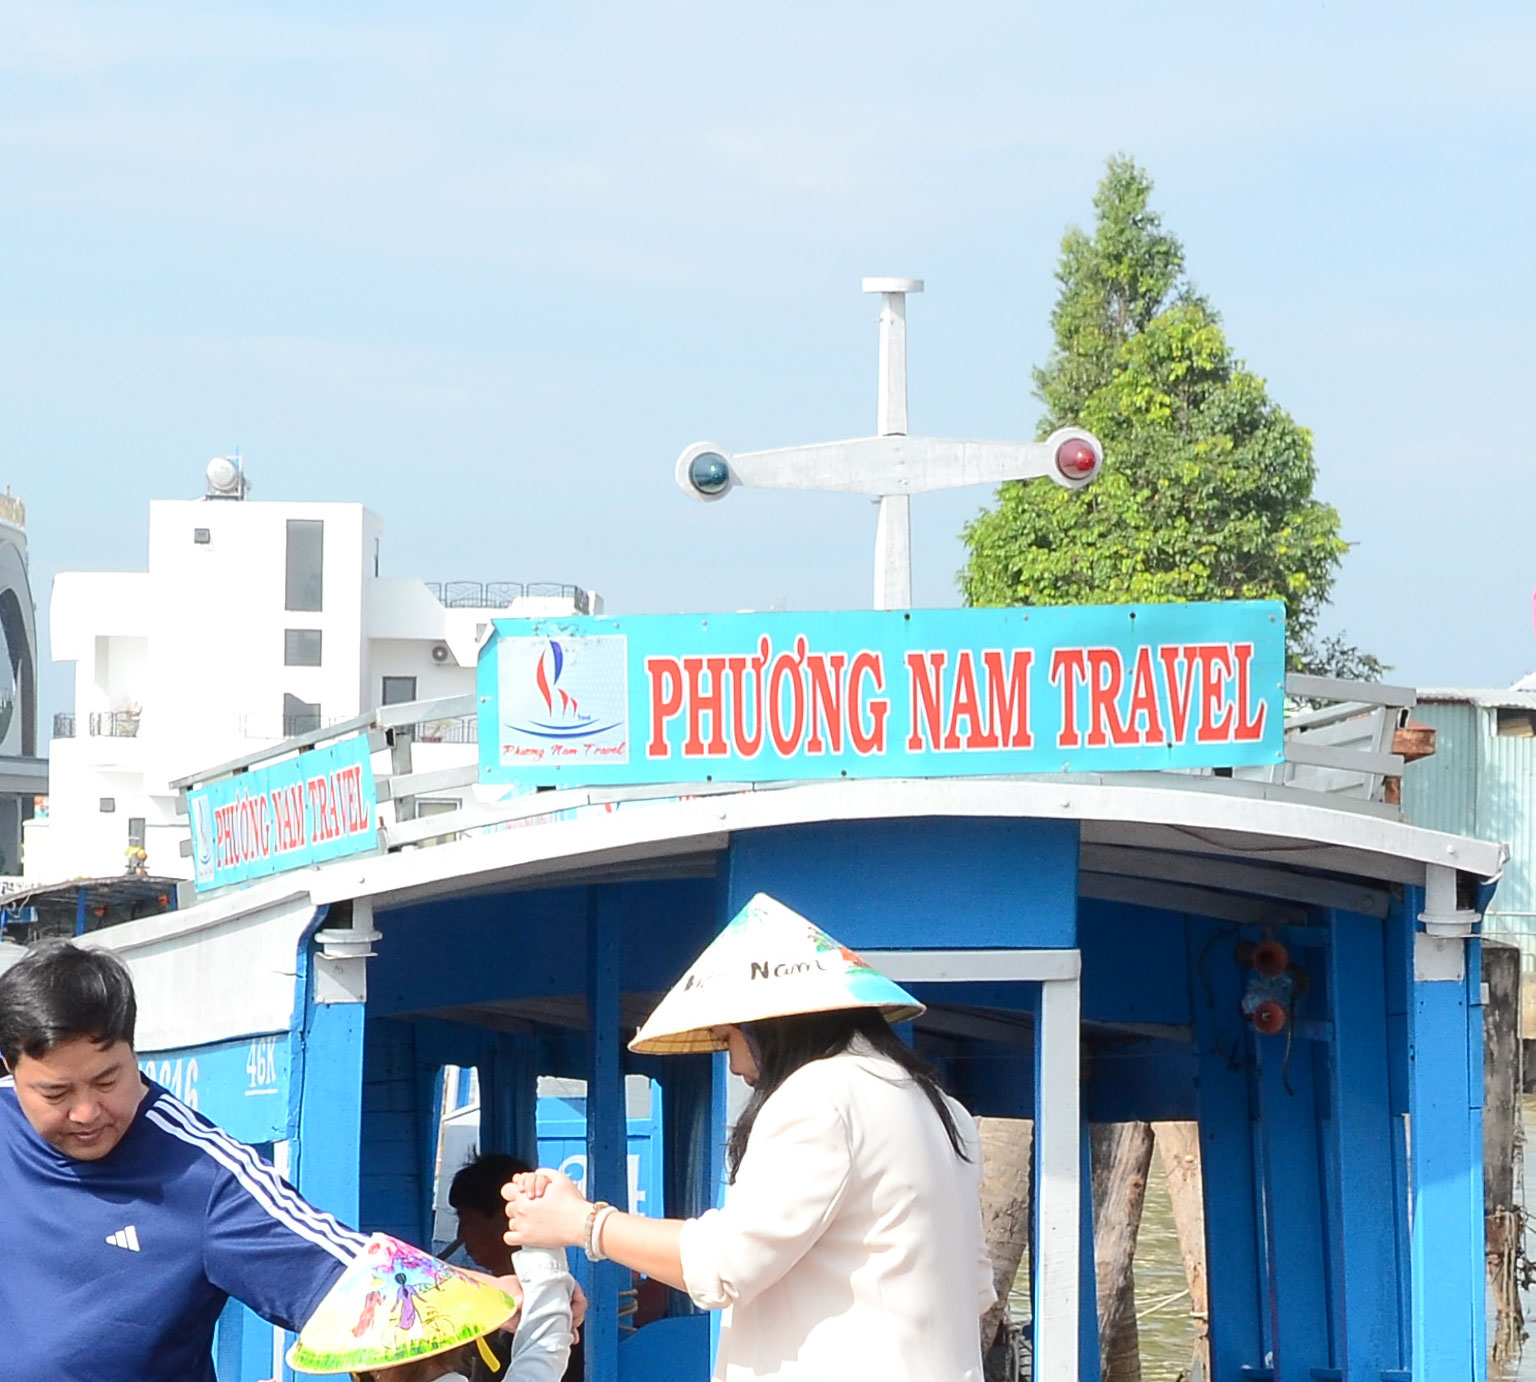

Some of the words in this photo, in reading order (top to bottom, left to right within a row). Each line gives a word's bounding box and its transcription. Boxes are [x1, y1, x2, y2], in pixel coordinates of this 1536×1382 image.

[647, 636, 887, 757] PHƯƠNG
[906, 650, 1032, 750] NAM
[1050, 644, 1265, 746] TRAVEL
[215, 787, 270, 868] PHƯƠNG
[271, 784, 305, 853] NAM
[308, 766, 370, 843] TRAVEL
[750, 958, 827, 980] Nam
[246, 1037, 276, 1088] 46K
